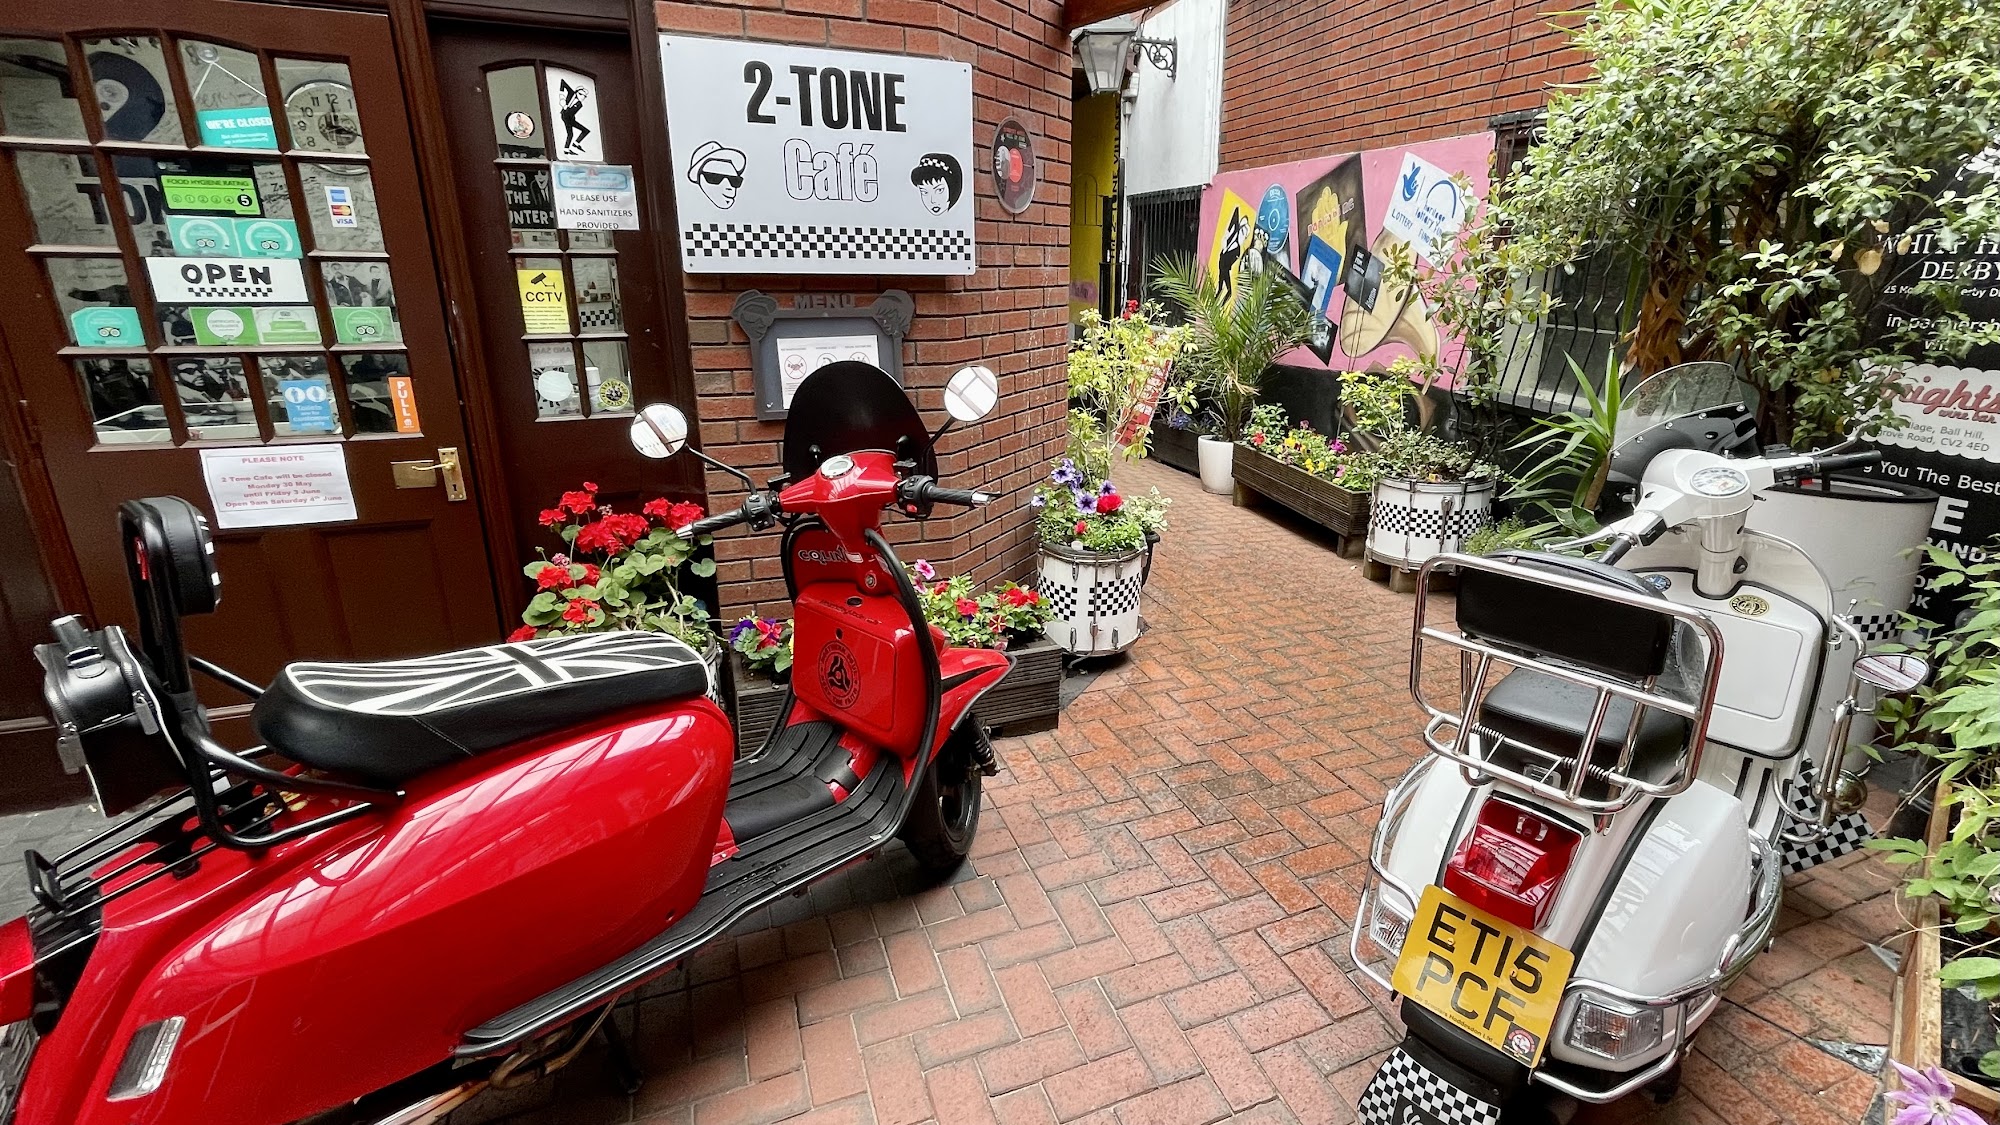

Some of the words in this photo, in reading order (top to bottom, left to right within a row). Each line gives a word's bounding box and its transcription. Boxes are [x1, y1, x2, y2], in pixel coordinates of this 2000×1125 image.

[743, 60, 907, 133] 2-TONE
[205, 119, 237, 130] WE'RE
[237, 117, 273, 128] CLOSED
[783, 138, 879, 202] Café
[240, 195, 250, 206] 5
[505, 190, 531, 205] THE
[571, 194, 600, 202] PLEASE
[560, 208, 584, 216] HAND
[586, 209, 633, 217] SANITIZERS
[1391, 208, 1414, 230] LOTTERY
[577, 221, 619, 230] PROVIDED
[181, 263, 272, 285] OPEN
[525, 291, 563, 302] CCTV
[795, 294, 856, 309] MENU
[396, 380, 411, 417] PULL
[1908, 422, 1935, 434] llage,
[1940, 426, 1960, 436] Ball
[1963, 429, 1985, 441] Hill,
[1907, 432, 1936, 445] Road,
[1940, 437, 1962, 448] CV2
[1966, 442, 1990, 452] 4ED
[242, 456, 277, 464] PLEASE
[1880, 460, 1909, 478] You
[1917, 467, 1951, 486] The
[1957, 475, 2000, 495] Best
[798, 545, 848, 565] COLIN
[1427, 901, 1551, 994] ET15
[1415, 950, 1527, 1031] PCF
